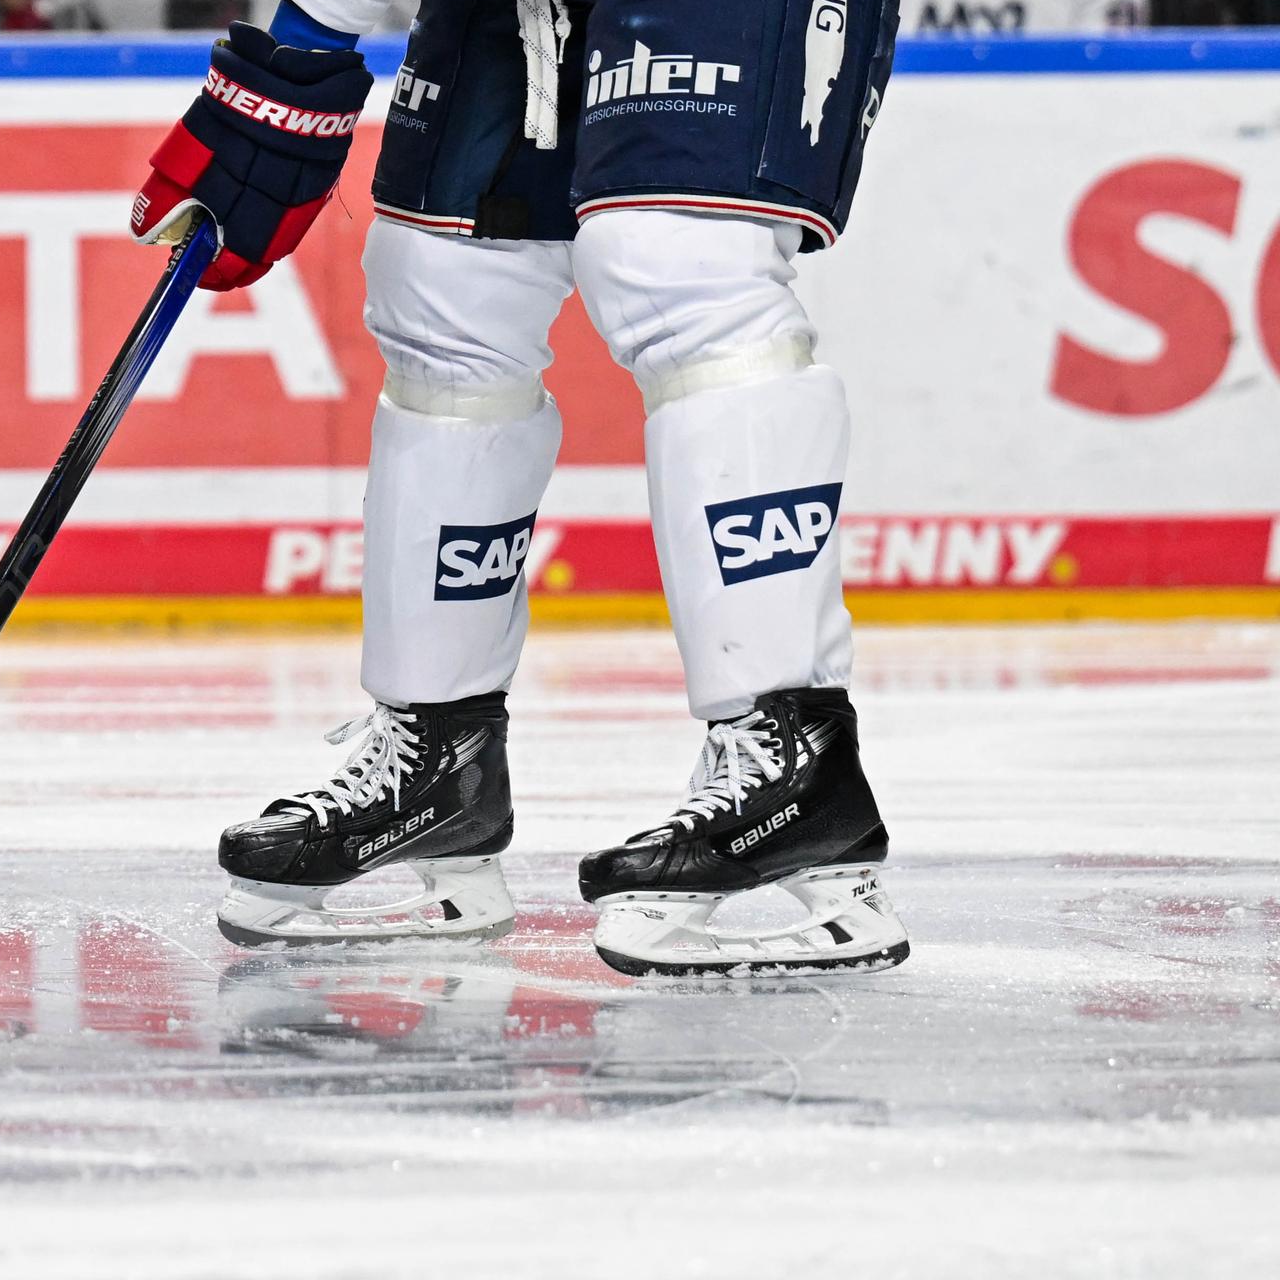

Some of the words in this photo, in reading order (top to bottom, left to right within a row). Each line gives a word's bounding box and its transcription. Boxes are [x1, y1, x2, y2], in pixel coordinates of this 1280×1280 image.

[585, 39, 741, 109] inter
[437, 527, 530, 589] SAP
[711, 500, 832, 570] SAP
[730, 801, 801, 855] BAUER
